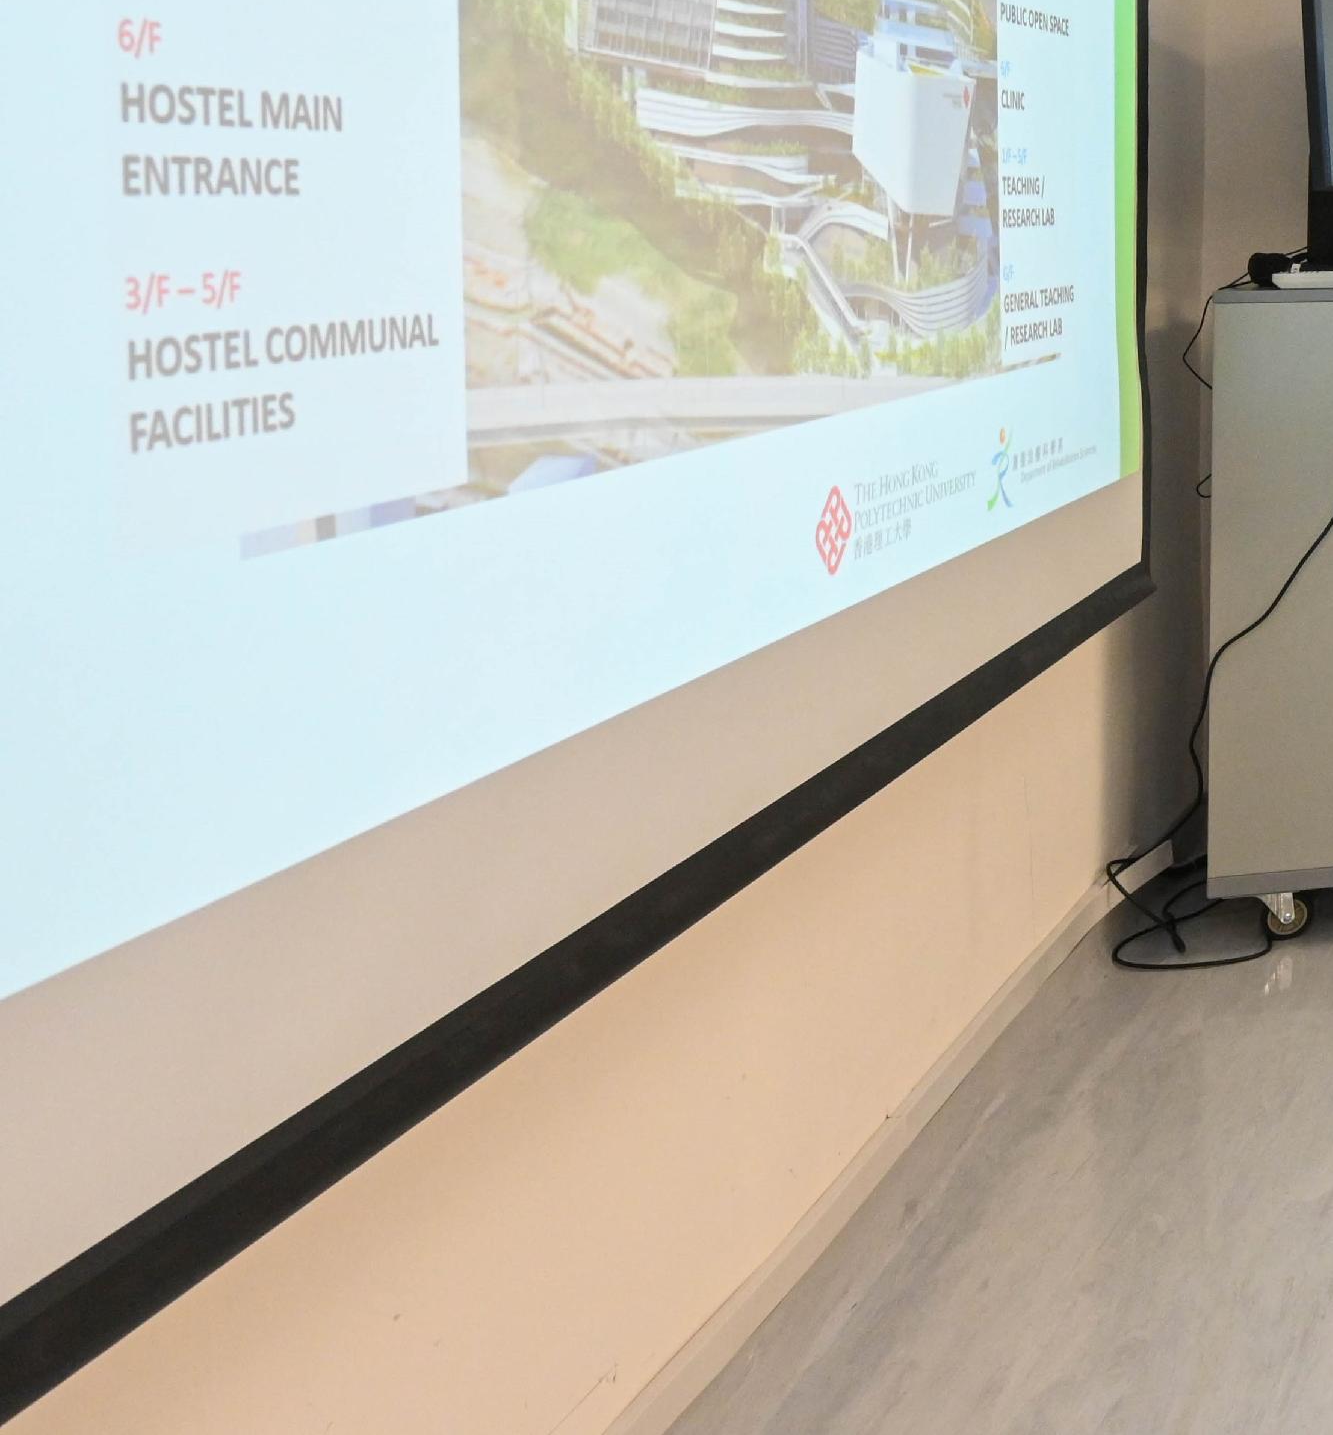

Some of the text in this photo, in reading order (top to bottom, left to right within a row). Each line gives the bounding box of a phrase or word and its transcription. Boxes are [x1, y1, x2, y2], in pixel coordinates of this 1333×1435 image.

[117, 18, 162, 59] 6/F
[1000, 2, 1070, 37] PUBLIC OPEN SPACE
[120, 81, 343, 133] HOSTEL MAIN
[1001, 89, 1025, 111] CLINIC
[121, 154, 300, 197] ENTRANCE
[1002, 176, 1040, 197] TEACHING
[1002, 207, 1055, 229] RESEARCH LAB
[125, 269, 241, 315] 3/F 5/F
[1004, 284, 1075, 314] GENERAL TEACHING
[128, 313, 440, 381] HOSTEL COMMUNAL
[1010, 321, 1048, 347] RESEARCH
[1049, 317, 1063, 338] LAB
[130, 391, 296, 454] FACILITIES
[854, 461, 939, 505] THE HONG KONG
[854, 470, 977, 533] POLYTECHNIC UNIVERSITY
